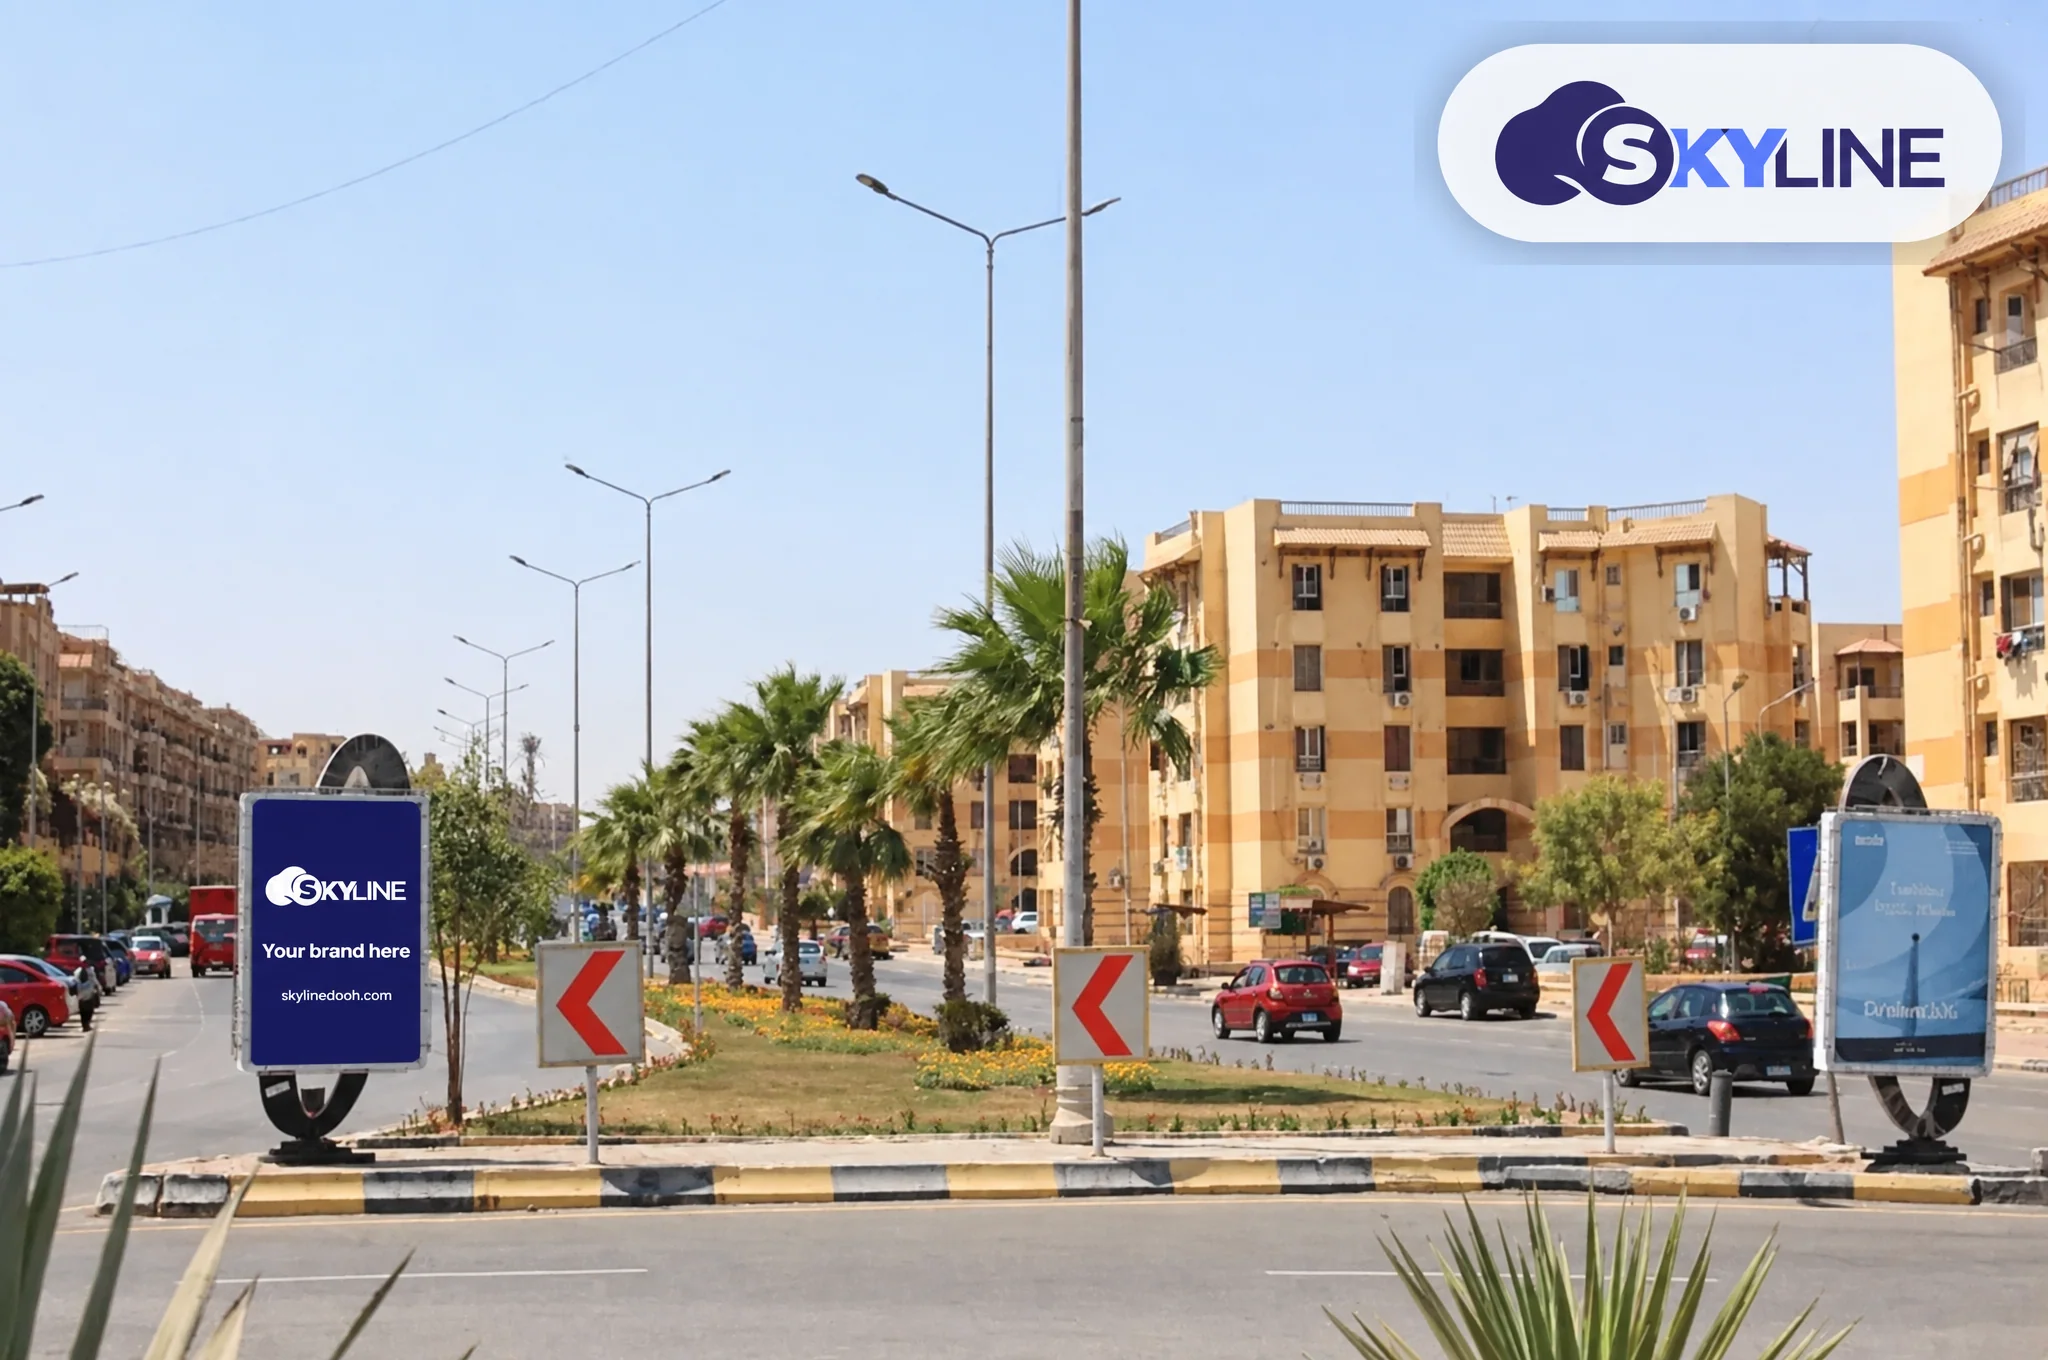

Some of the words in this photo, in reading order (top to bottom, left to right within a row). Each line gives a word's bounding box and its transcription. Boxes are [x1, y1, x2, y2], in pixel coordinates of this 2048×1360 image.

[298, 879, 407, 901] SKYLINE
[262, 943, 306, 959] Your
[309, 942, 365, 959] brand
[369, 942, 411, 959] here
[281, 989, 392, 1004] skylinedooh.com
